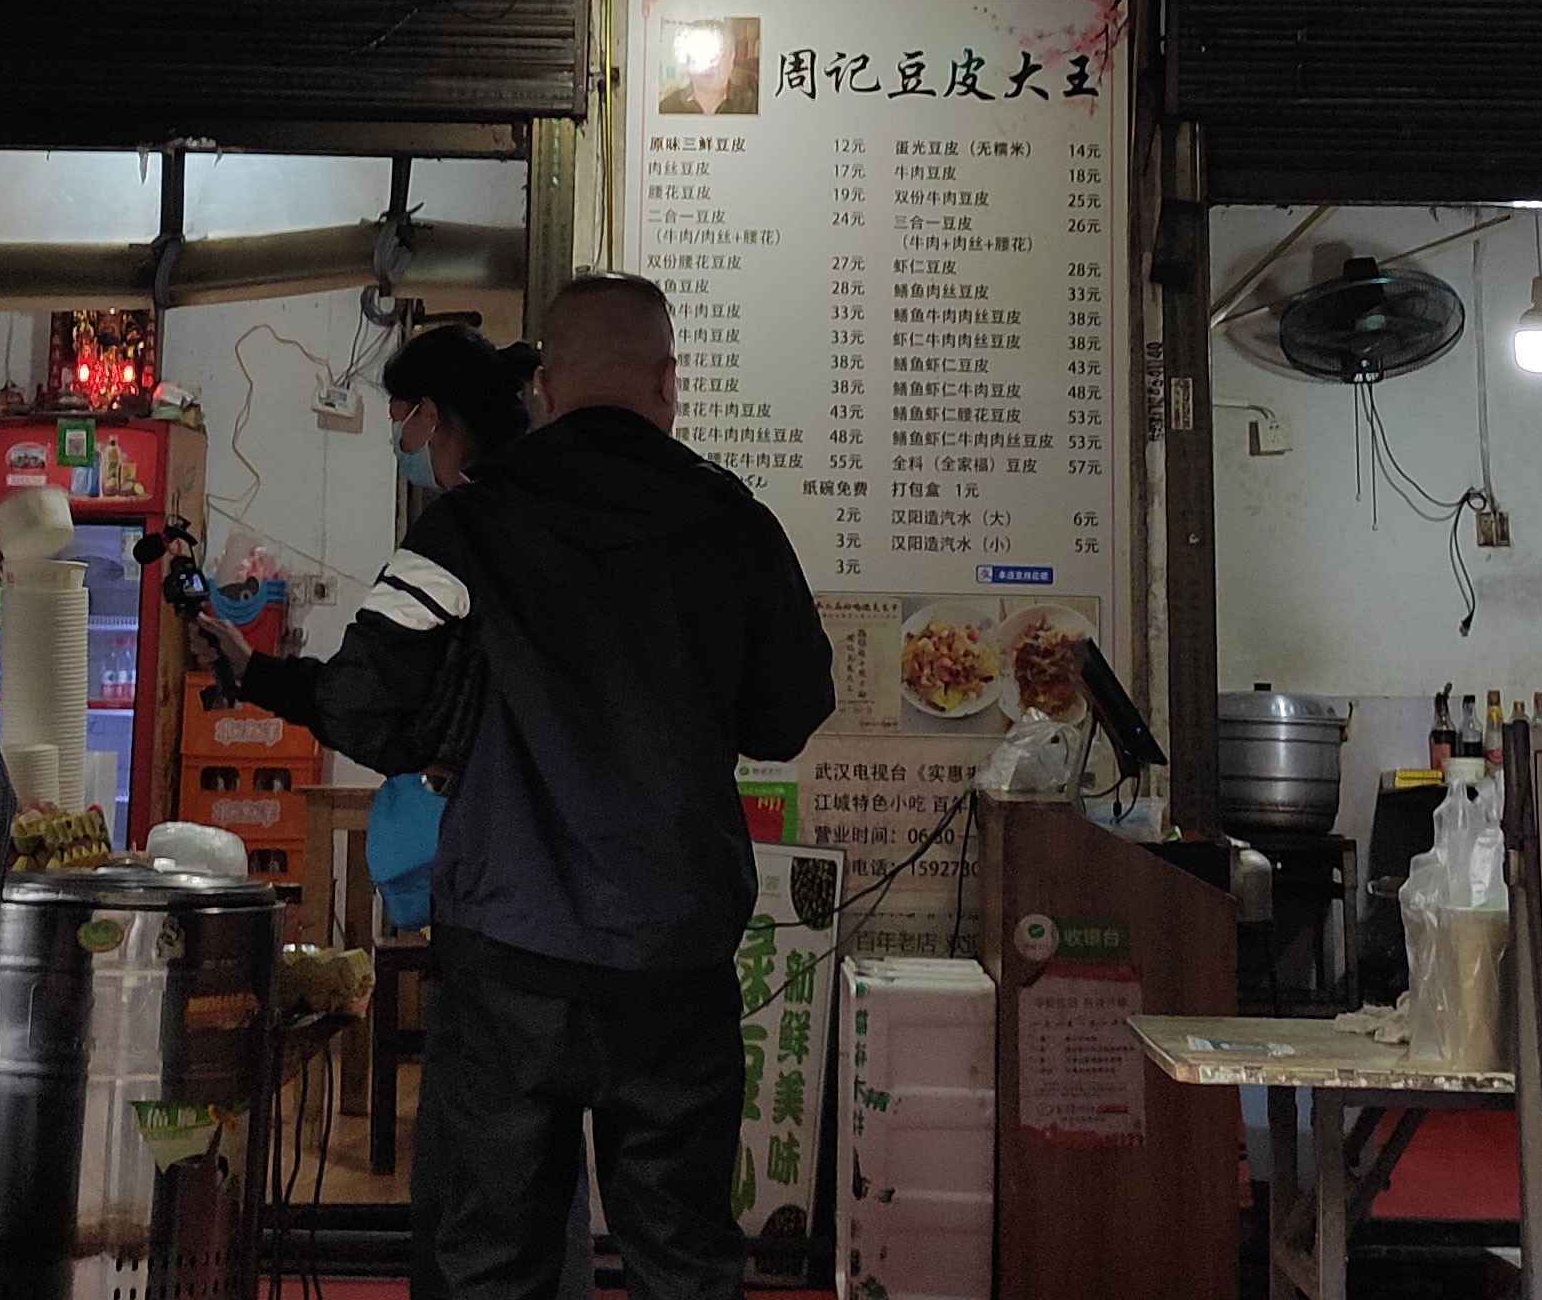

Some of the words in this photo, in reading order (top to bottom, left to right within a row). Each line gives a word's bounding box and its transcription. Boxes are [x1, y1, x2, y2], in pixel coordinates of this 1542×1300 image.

[775, 47, 1100, 101] 周记豆皮大王
[650, 137, 746, 152] 原味三鲜豆皮
[834, 139, 866, 153] 12元
[1068, 144, 1101, 159] 14元
[648, 161, 711, 176] 肉丝豆皮
[834, 164, 866, 179] 17元
[894, 165, 956, 181] 牛肉豆皮
[1068, 168, 1101, 183] 18元
[648, 184, 711, 200] 腰花豆皮
[834, 187, 866, 202] 19元
[895, 190, 989, 207] 双份牛肉豆皮
[1068, 194, 1101, 208] 25元
[648, 209, 726, 224] 二合一豆皮
[832, 211, 866, 226] 24元
[894, 215, 972, 231] 三合一豆皮
[1068, 219, 1101, 234] 26元
[647, 254, 742, 270] 双份腰花豆皮
[832, 256, 866, 271] 27元
[894, 259, 956, 275] 虾仁豆皮
[1068, 263, 1101, 277] 28元
[653, 279, 709, 294] 鱼豆皮
[832, 281, 865, 295] 28元
[894, 283, 989, 300] 鳝鱼肉丝豆皮
[1068, 287, 1101, 302] 33元
[832, 305, 865, 320] 33元
[1068, 312, 1101, 327] 38元
[831, 330, 865, 345] 33元
[893, 332, 1021, 349] 虾仁牛肉肉丝豆皮
[1068, 337, 1101, 351] 38元
[831, 355, 864, 370] 38元
[1068, 361, 1101, 375] 43元
[831, 380, 865, 394] 38元
[1068, 386, 1101, 400] 48元
[830, 405, 864, 419] 43元
[1068, 411, 1102, 425] 53元
[829, 429, 863, 444] 48元
[1068, 436, 1102, 450] 53元
[829, 455, 863, 469] 55元
[1068, 460, 1102, 475] 57元
[803, 480, 868, 497] 纸碗免费
[892, 482, 940, 497] 打包盒
[955, 482, 981, 498] 1元
[836, 507, 861, 522] 2元
[1073, 512, 1099, 527] 6元
[836, 533, 861, 548] 3元
[1075, 538, 1099, 553] 5元
[836, 559, 861, 574] 3元
[815, 794, 926, 813] 江城特色小吃
[1064, 928, 1120, 947] 收银台
